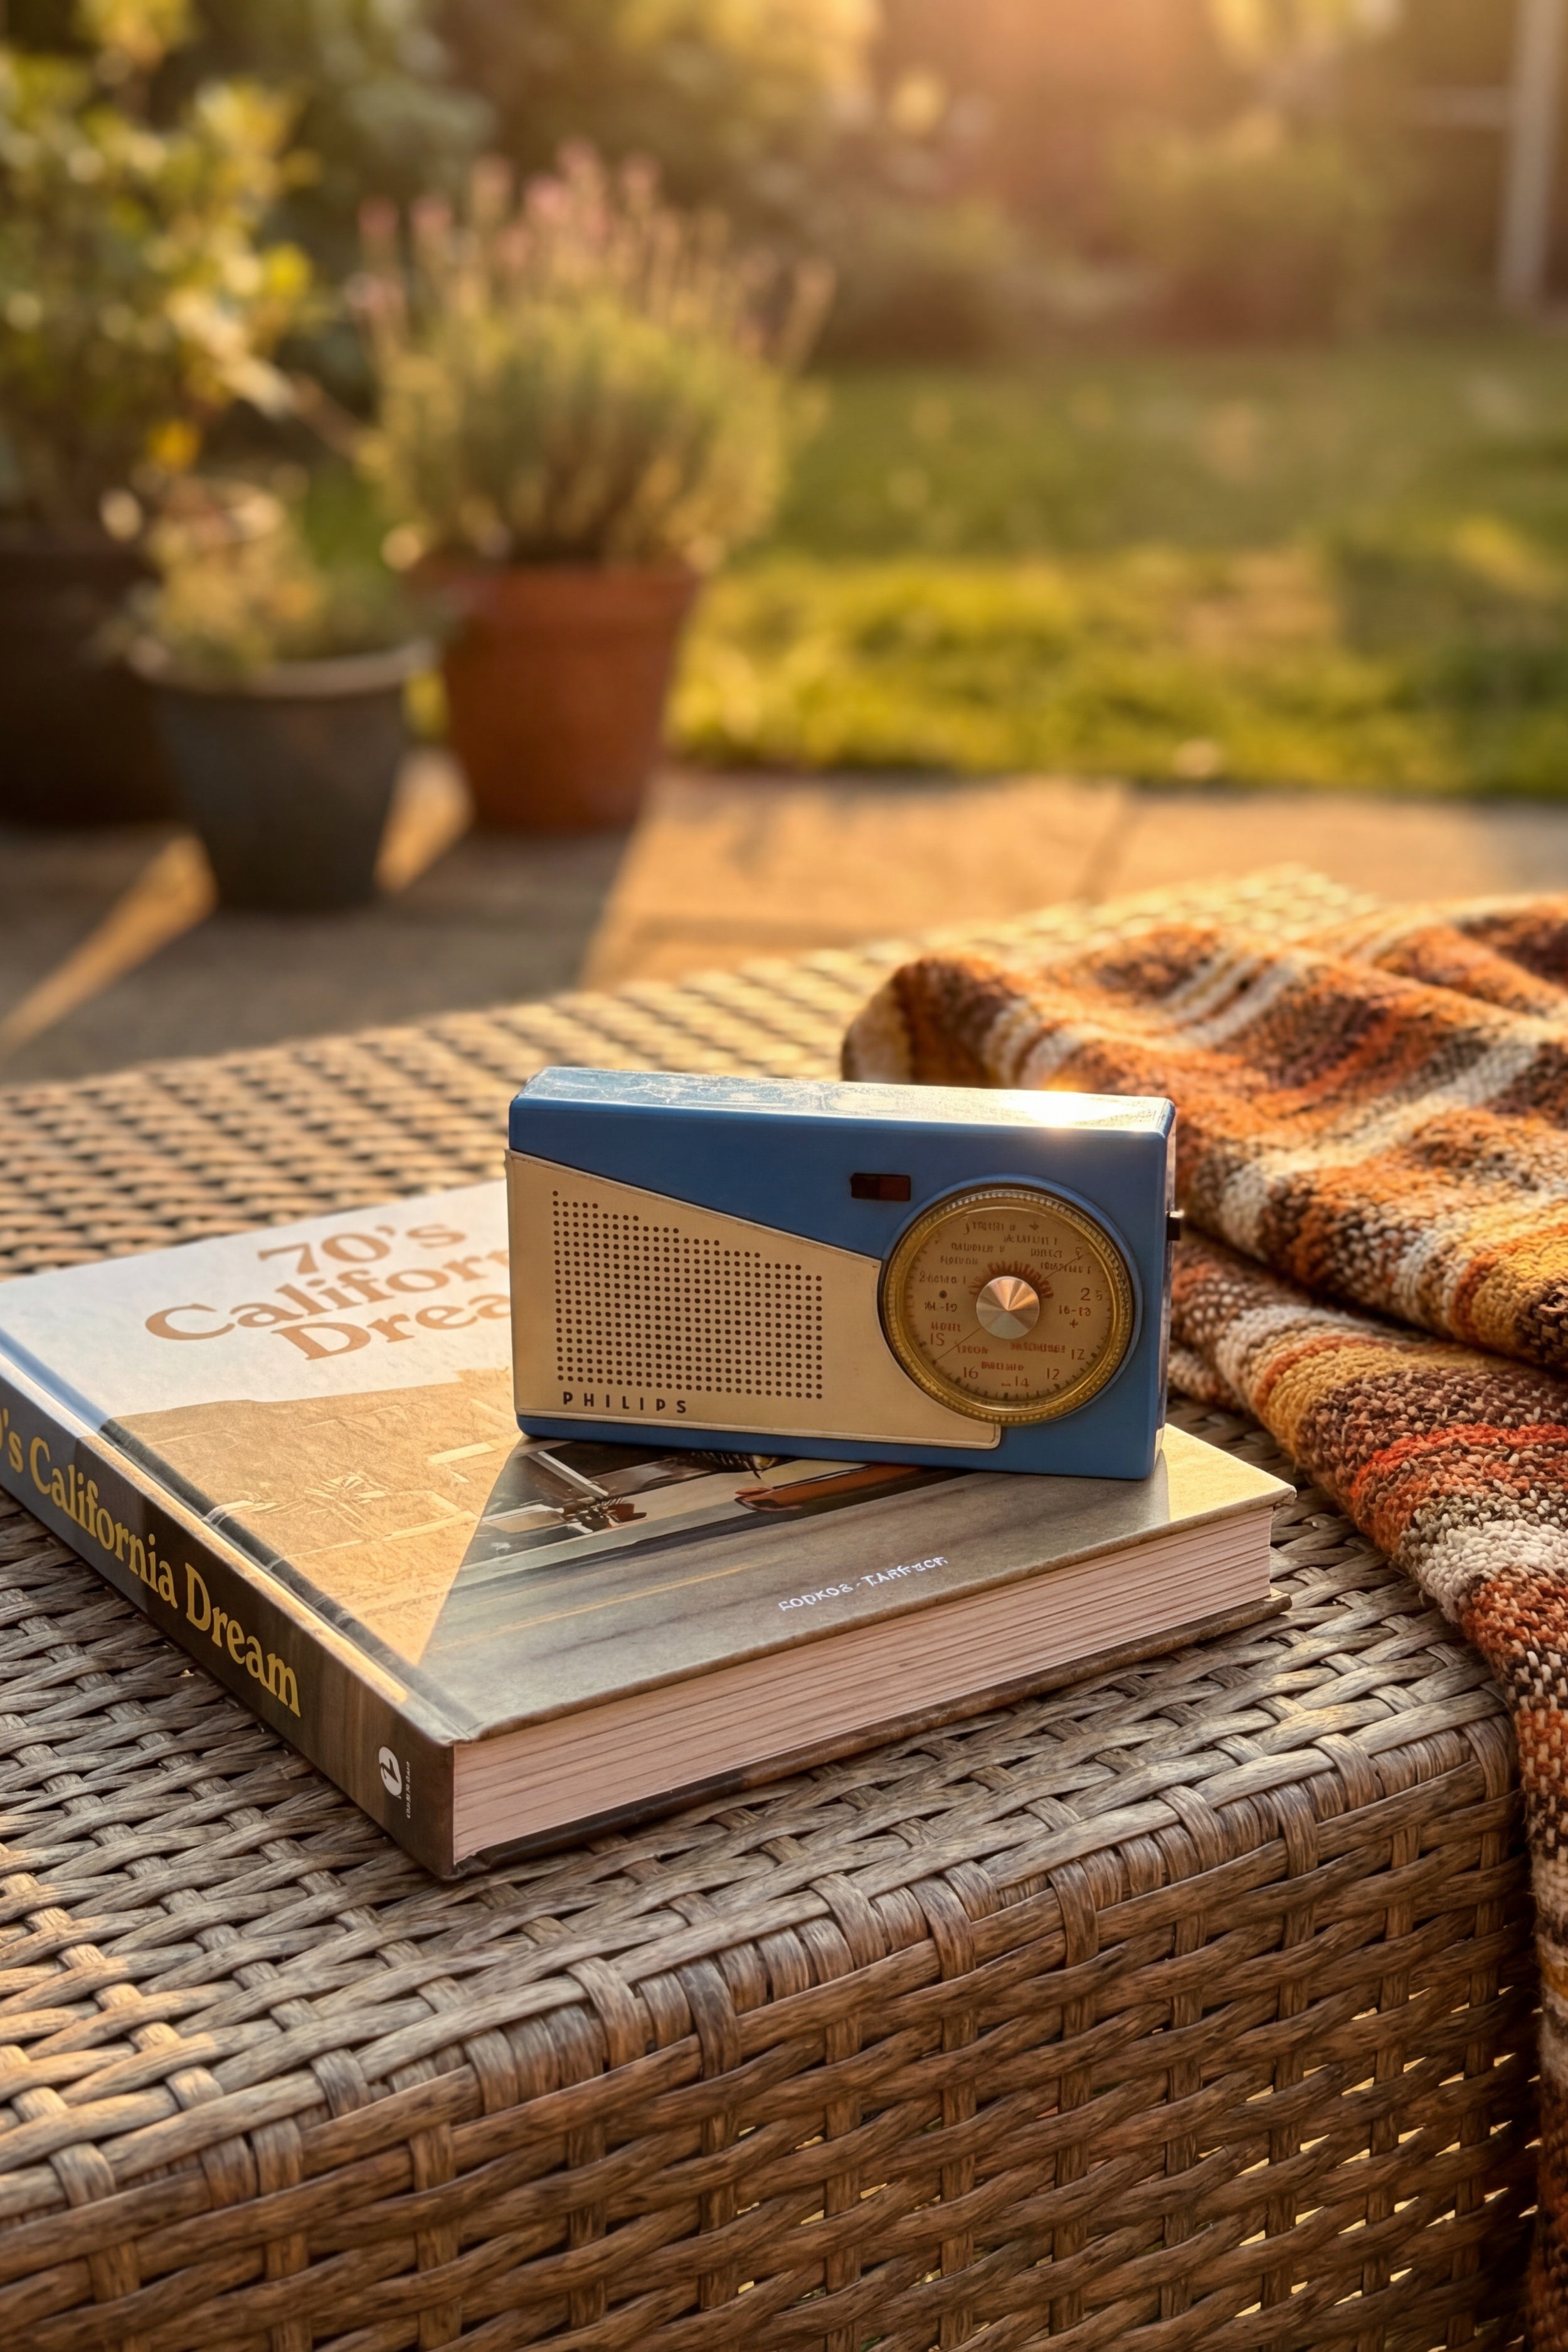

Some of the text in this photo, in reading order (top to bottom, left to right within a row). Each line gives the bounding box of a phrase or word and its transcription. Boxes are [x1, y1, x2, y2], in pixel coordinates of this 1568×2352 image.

[258, 1224, 467, 1274] 70's
[963, 1366, 978, 1379] 16
[1015, 1375, 1030, 1387] 14
[1047, 1368, 1060, 1380] 12
[563, 1391, 687, 1414] PHILIPS
[0, 1407, 301, 1718] 's California Dream
